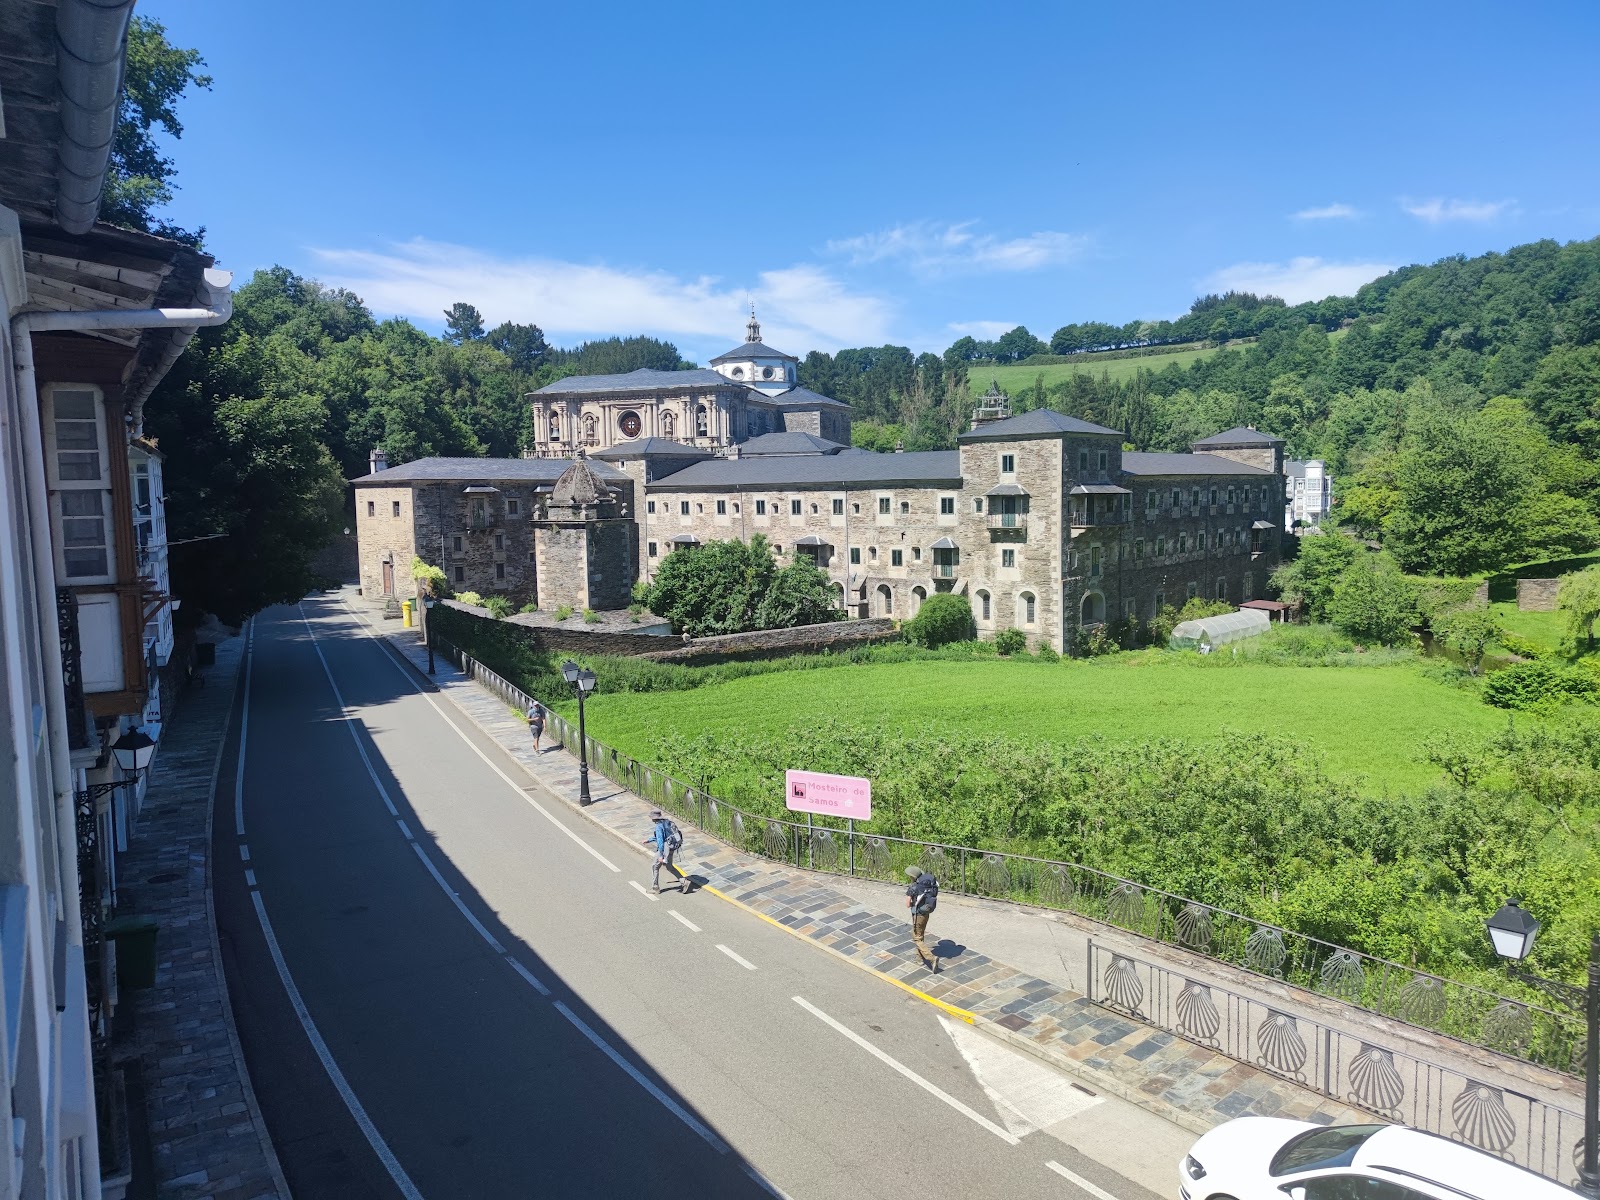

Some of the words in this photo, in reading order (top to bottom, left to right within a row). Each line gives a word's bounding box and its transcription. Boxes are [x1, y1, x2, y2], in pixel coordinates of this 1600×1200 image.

[808, 782, 848, 794] Mosteiro
[853, 788, 865, 796] de
[808, 797, 839, 807] Samos
